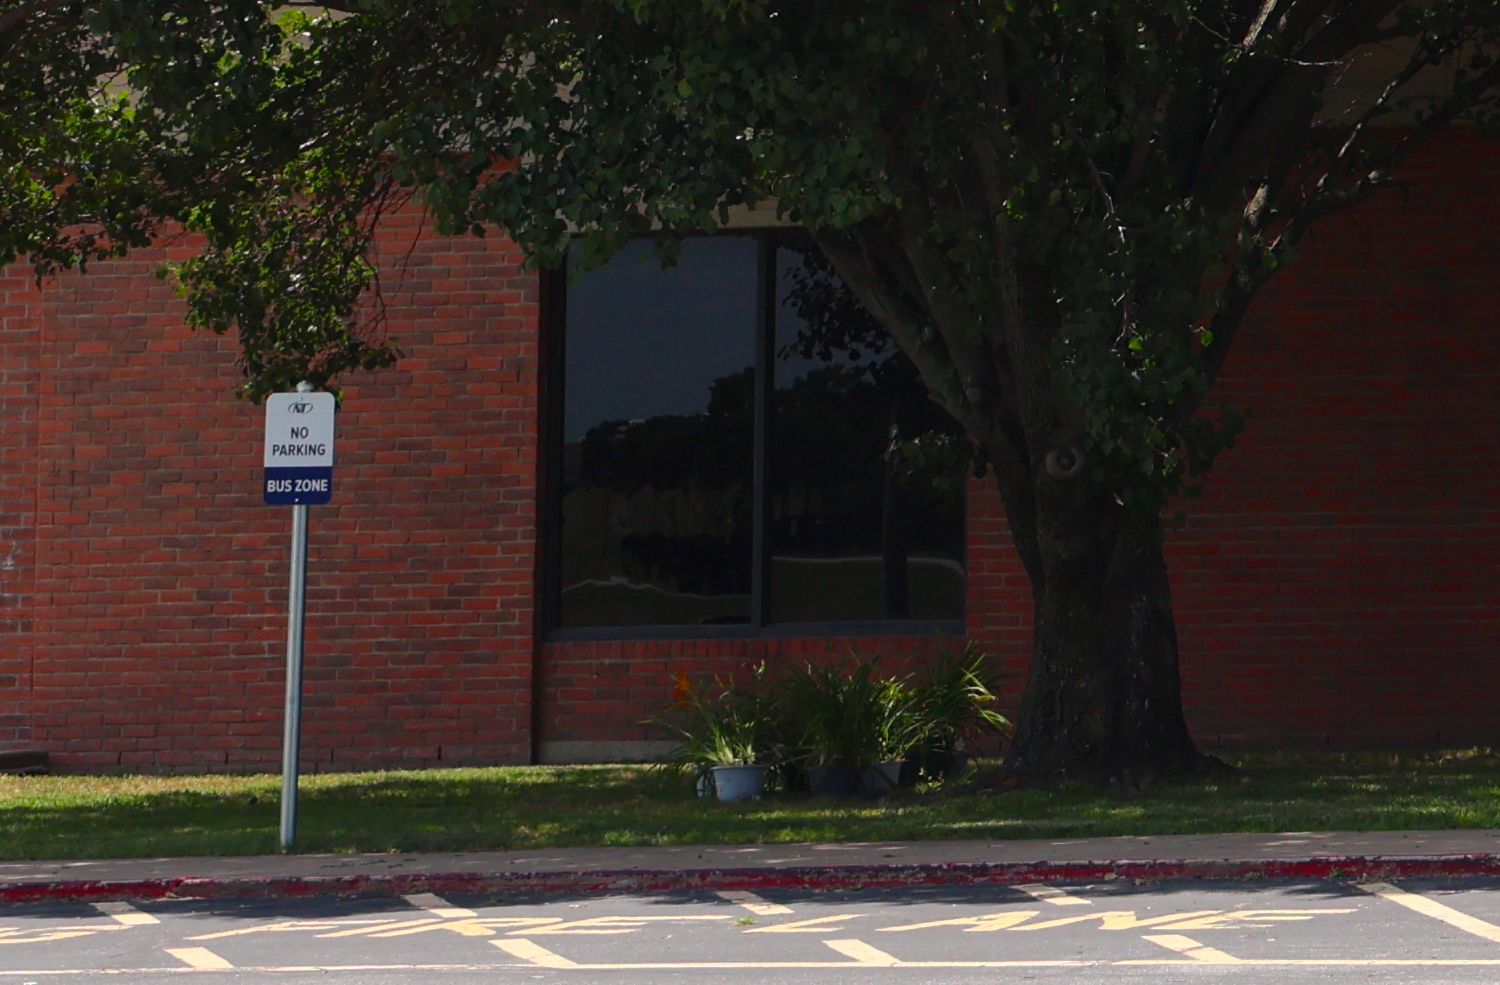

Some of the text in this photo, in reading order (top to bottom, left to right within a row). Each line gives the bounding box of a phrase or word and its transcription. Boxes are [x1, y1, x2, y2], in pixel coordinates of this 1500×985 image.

[290, 426, 309, 439] NO
[272, 443, 326, 456] PARKING
[266, 479, 328, 493] BUS ZONE
[183, 909, 1359, 940] FIRE LANE
